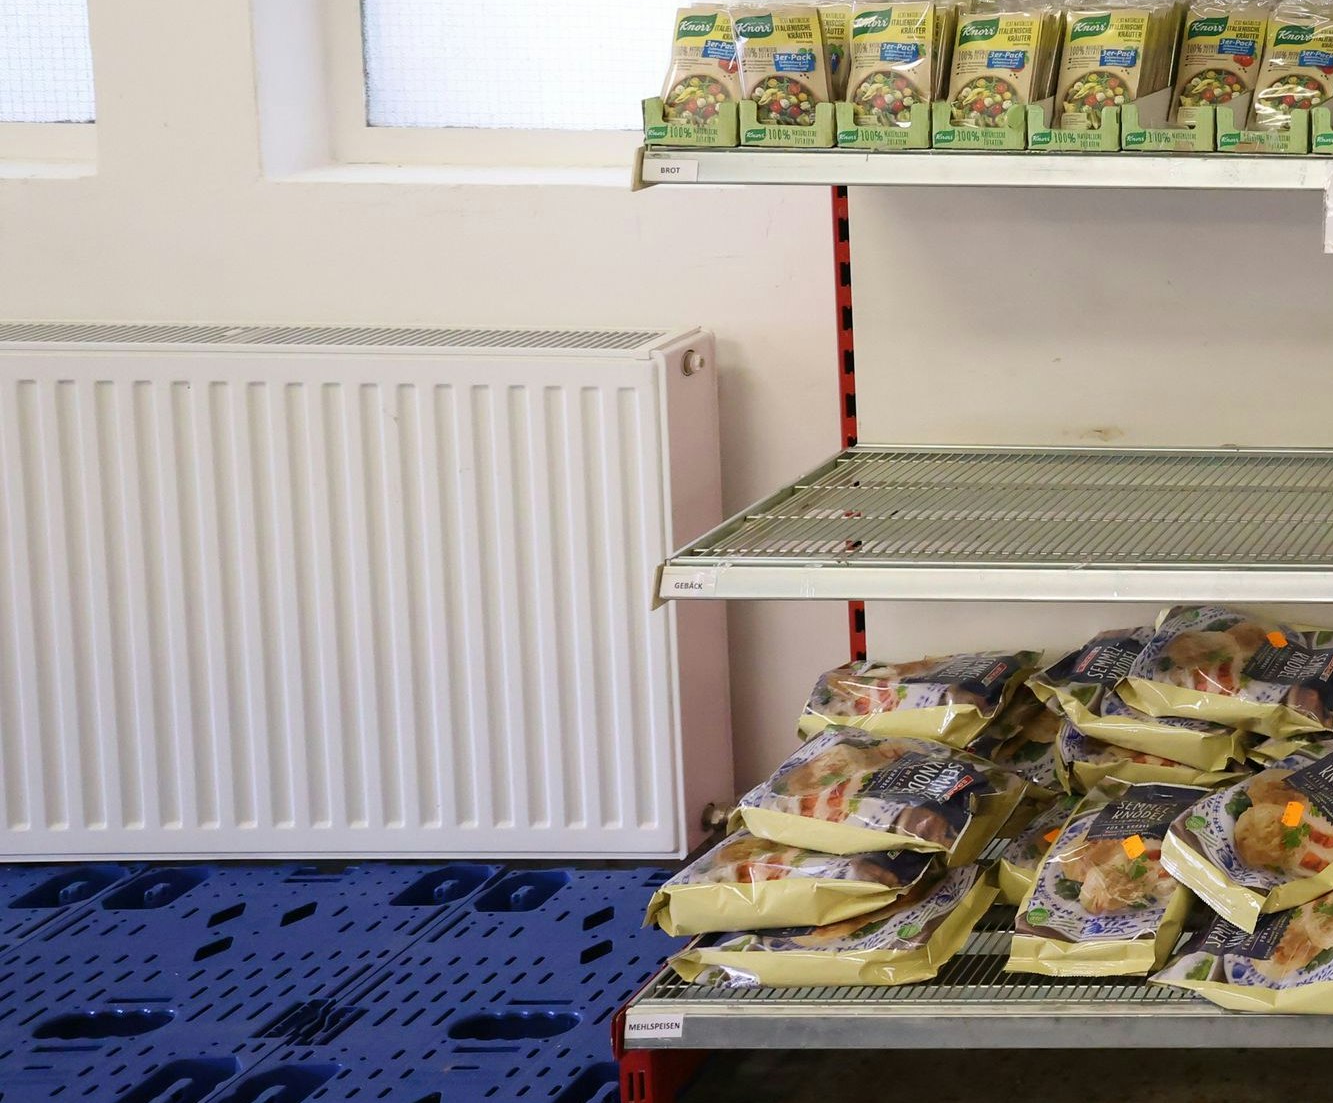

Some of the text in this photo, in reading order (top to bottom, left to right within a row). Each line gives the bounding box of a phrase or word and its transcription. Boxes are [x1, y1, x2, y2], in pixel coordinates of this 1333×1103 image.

[679, 21, 713, 32] Knorr
[736, 22, 771, 33] Knorr
[962, 25, 997, 36] Knorr
[1074, 21, 1109, 32] Knorr
[1192, 23, 1224, 33] Knorr
[768, 129, 791, 140] 100%
[674, 581, 703, 589] GEBÄCK
[629, 1023, 680, 1031] MEHLSPEISEN
